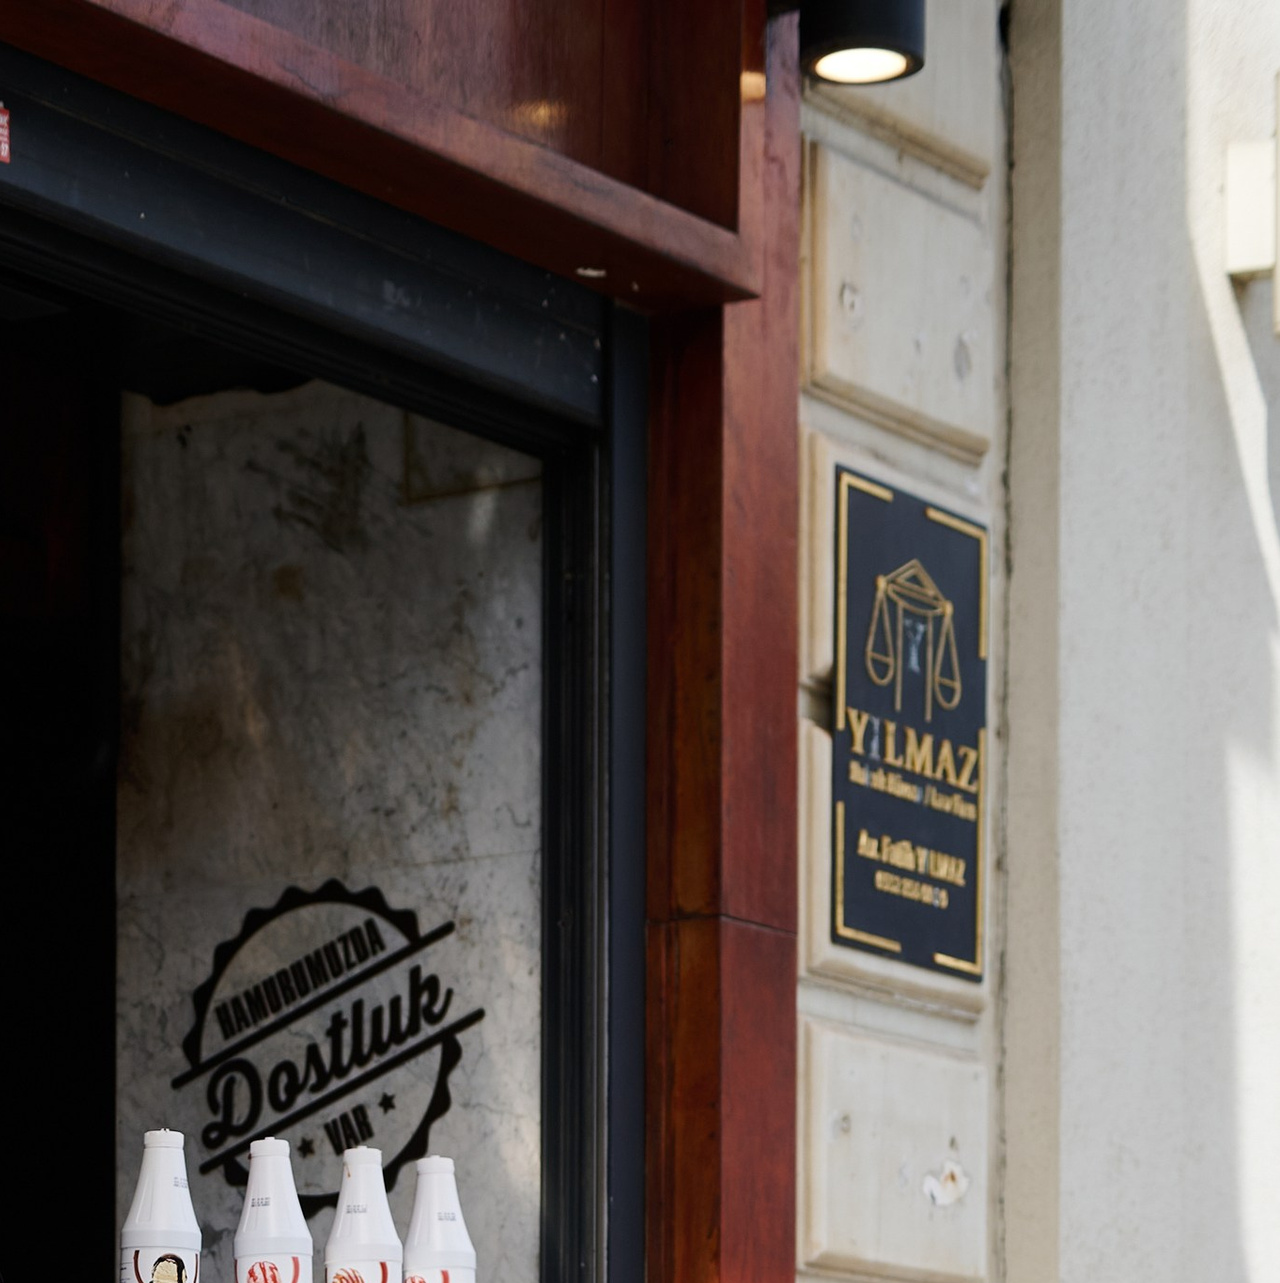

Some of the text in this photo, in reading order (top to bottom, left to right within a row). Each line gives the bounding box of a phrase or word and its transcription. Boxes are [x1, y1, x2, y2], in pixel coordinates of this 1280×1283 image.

[846, 706, 979, 795] YILMAZ
[214, 917, 386, 1041] HAMURUMUZDA
[201, 964, 454, 1150] Dostluk
[324, 1103, 375, 1156] VAR
